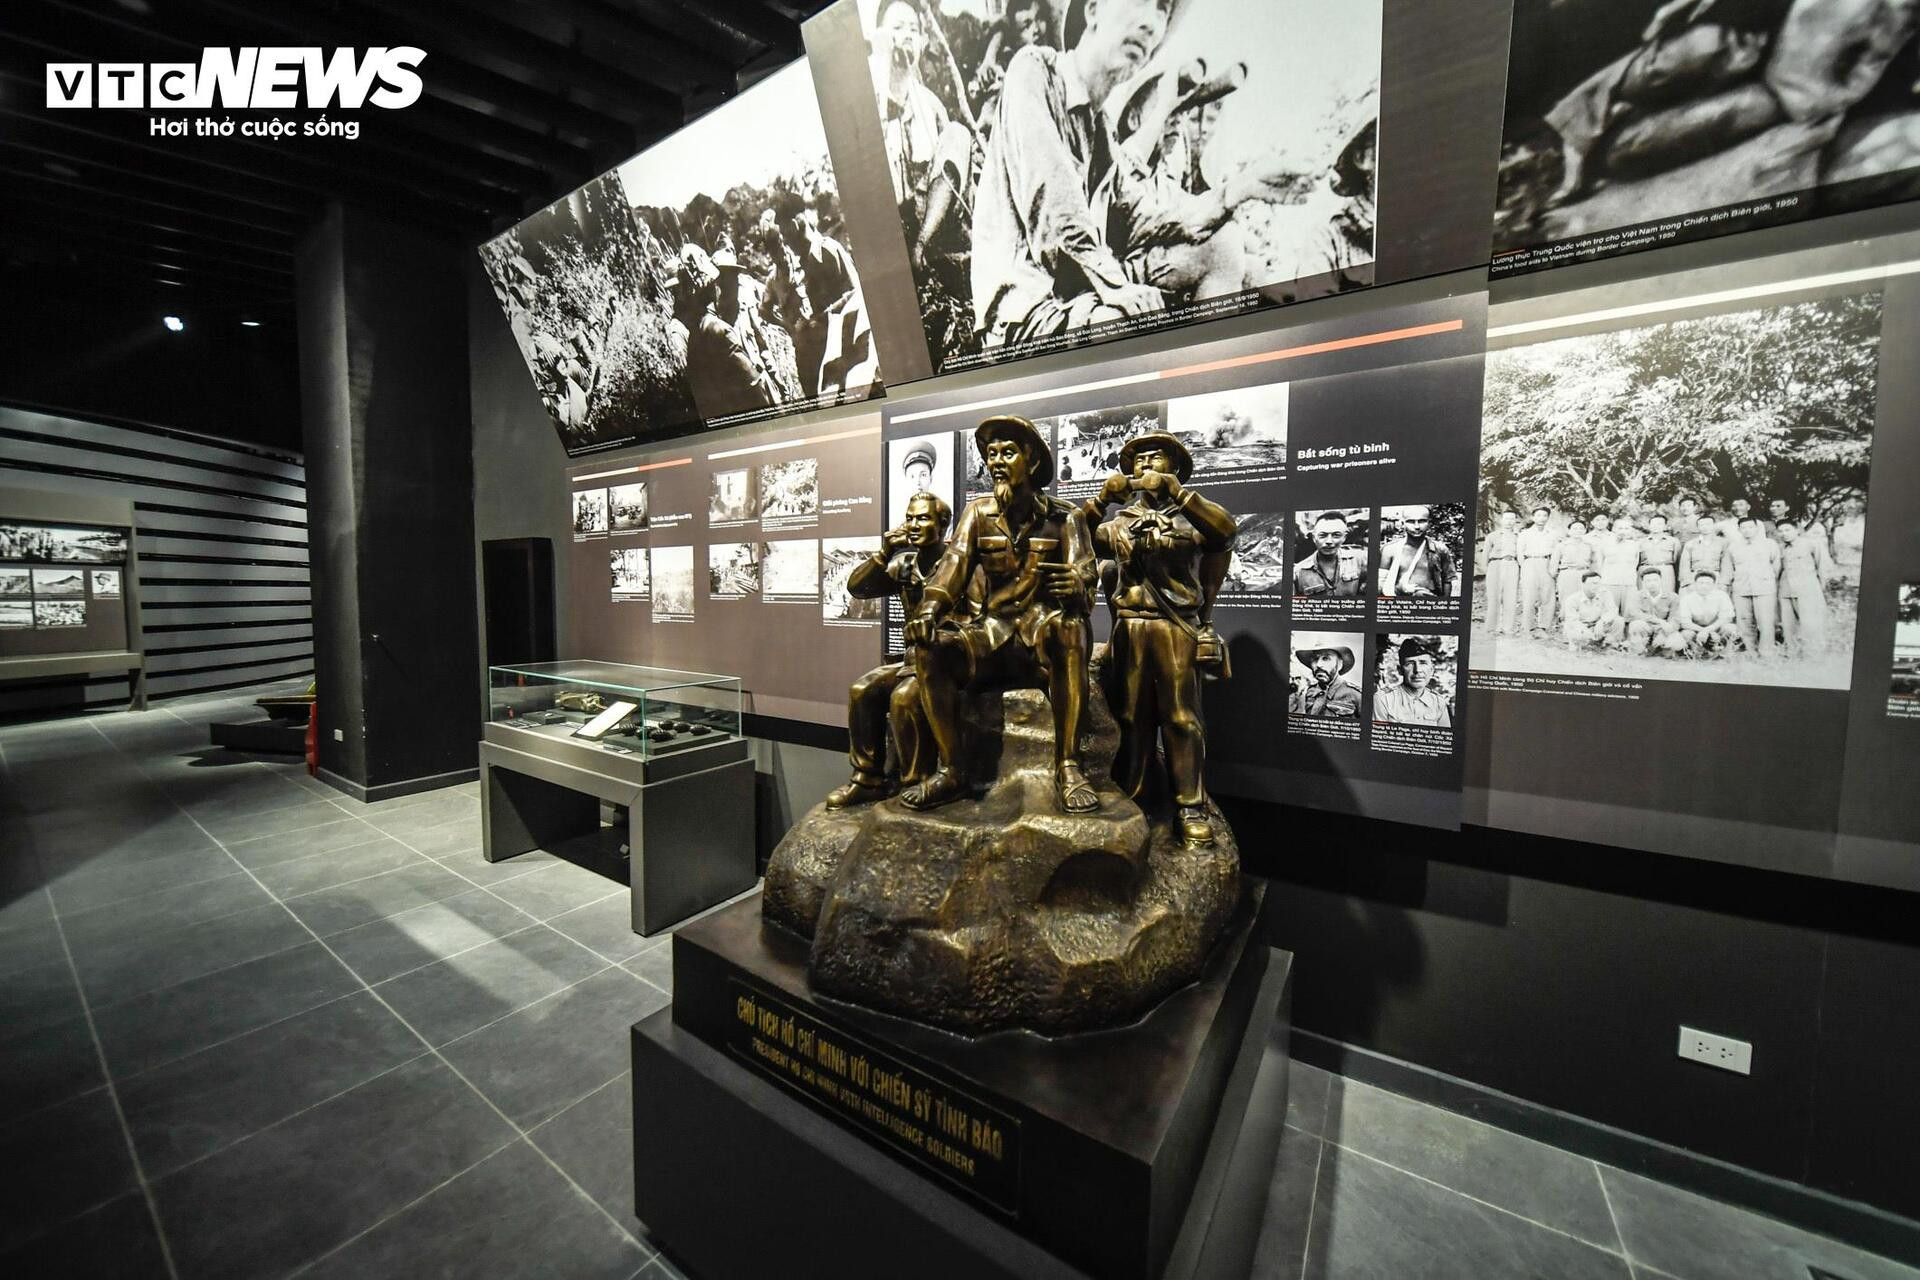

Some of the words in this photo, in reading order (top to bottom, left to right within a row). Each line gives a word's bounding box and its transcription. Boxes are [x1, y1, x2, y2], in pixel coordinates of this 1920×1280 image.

[1515, 252, 1531, 261] thực
[1532, 247, 1553, 257] Trung
[1554, 243, 1574, 252] Quốc
[1575, 239, 1592, 248] viện
[1605, 233, 1620, 242] cho
[1621, 229, 1637, 239] Việt
[1638, 226, 1658, 236] Nam
[1660, 221, 1681, 232] trong
[1710, 211, 1729, 222] dịch
[1731, 208, 1752, 218] Biên
[1775, 197, 1798, 209] 1950
[1296, 462, 1330, 472] Capturing
[1344, 459, 1378, 468] prisoners
[1378, 457, 1397, 465] alive
[1297, 447, 1317, 460] Bắt
[1318, 446, 1347, 458] sống
[1349, 444, 1361, 455] tù
[1363, 442, 1390, 453] binh
[797, 1028, 816, 1059] CHÍ
[817, 1038, 847, 1079] MINH
[850, 1055, 870, 1090] VỚI
[871, 1067, 911, 1111] CHIẾN
[935, 1096, 968, 1143] TÌNH
[971, 1117, 1003, 1162] BÁO
[927, 1135, 975, 1176] SOLDIERS
